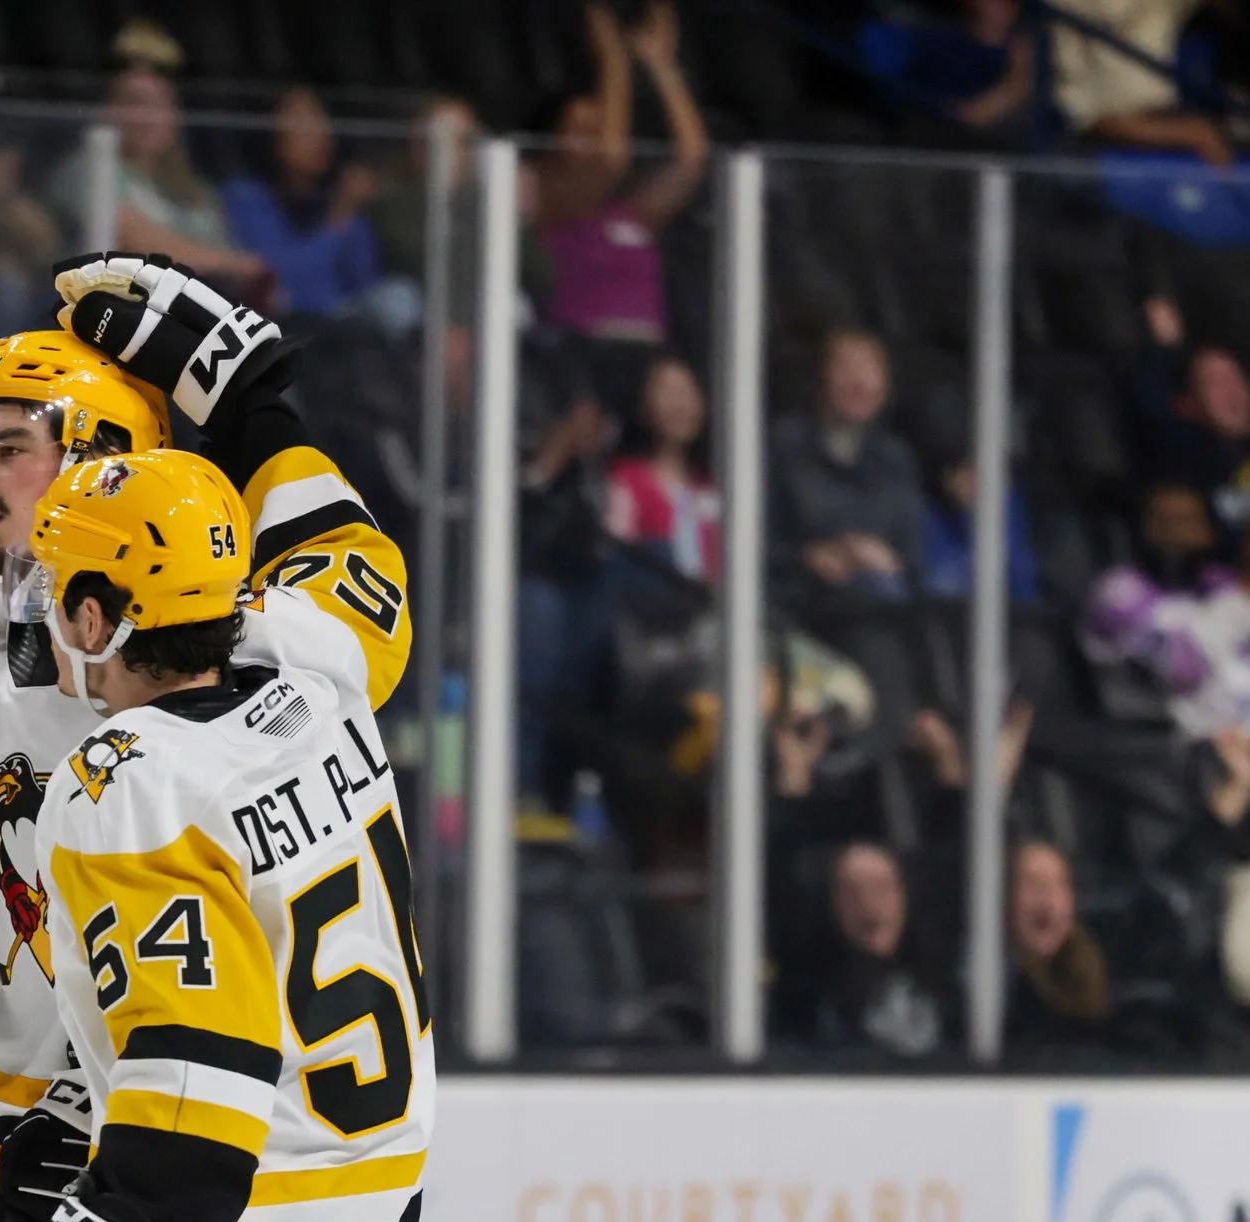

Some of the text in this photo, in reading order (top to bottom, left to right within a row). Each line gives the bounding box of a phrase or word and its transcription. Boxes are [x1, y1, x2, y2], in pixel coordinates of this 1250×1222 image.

[93, 307, 113, 344] CCM
[208, 523, 238, 560] 54
[244, 681, 295, 729] CCM
